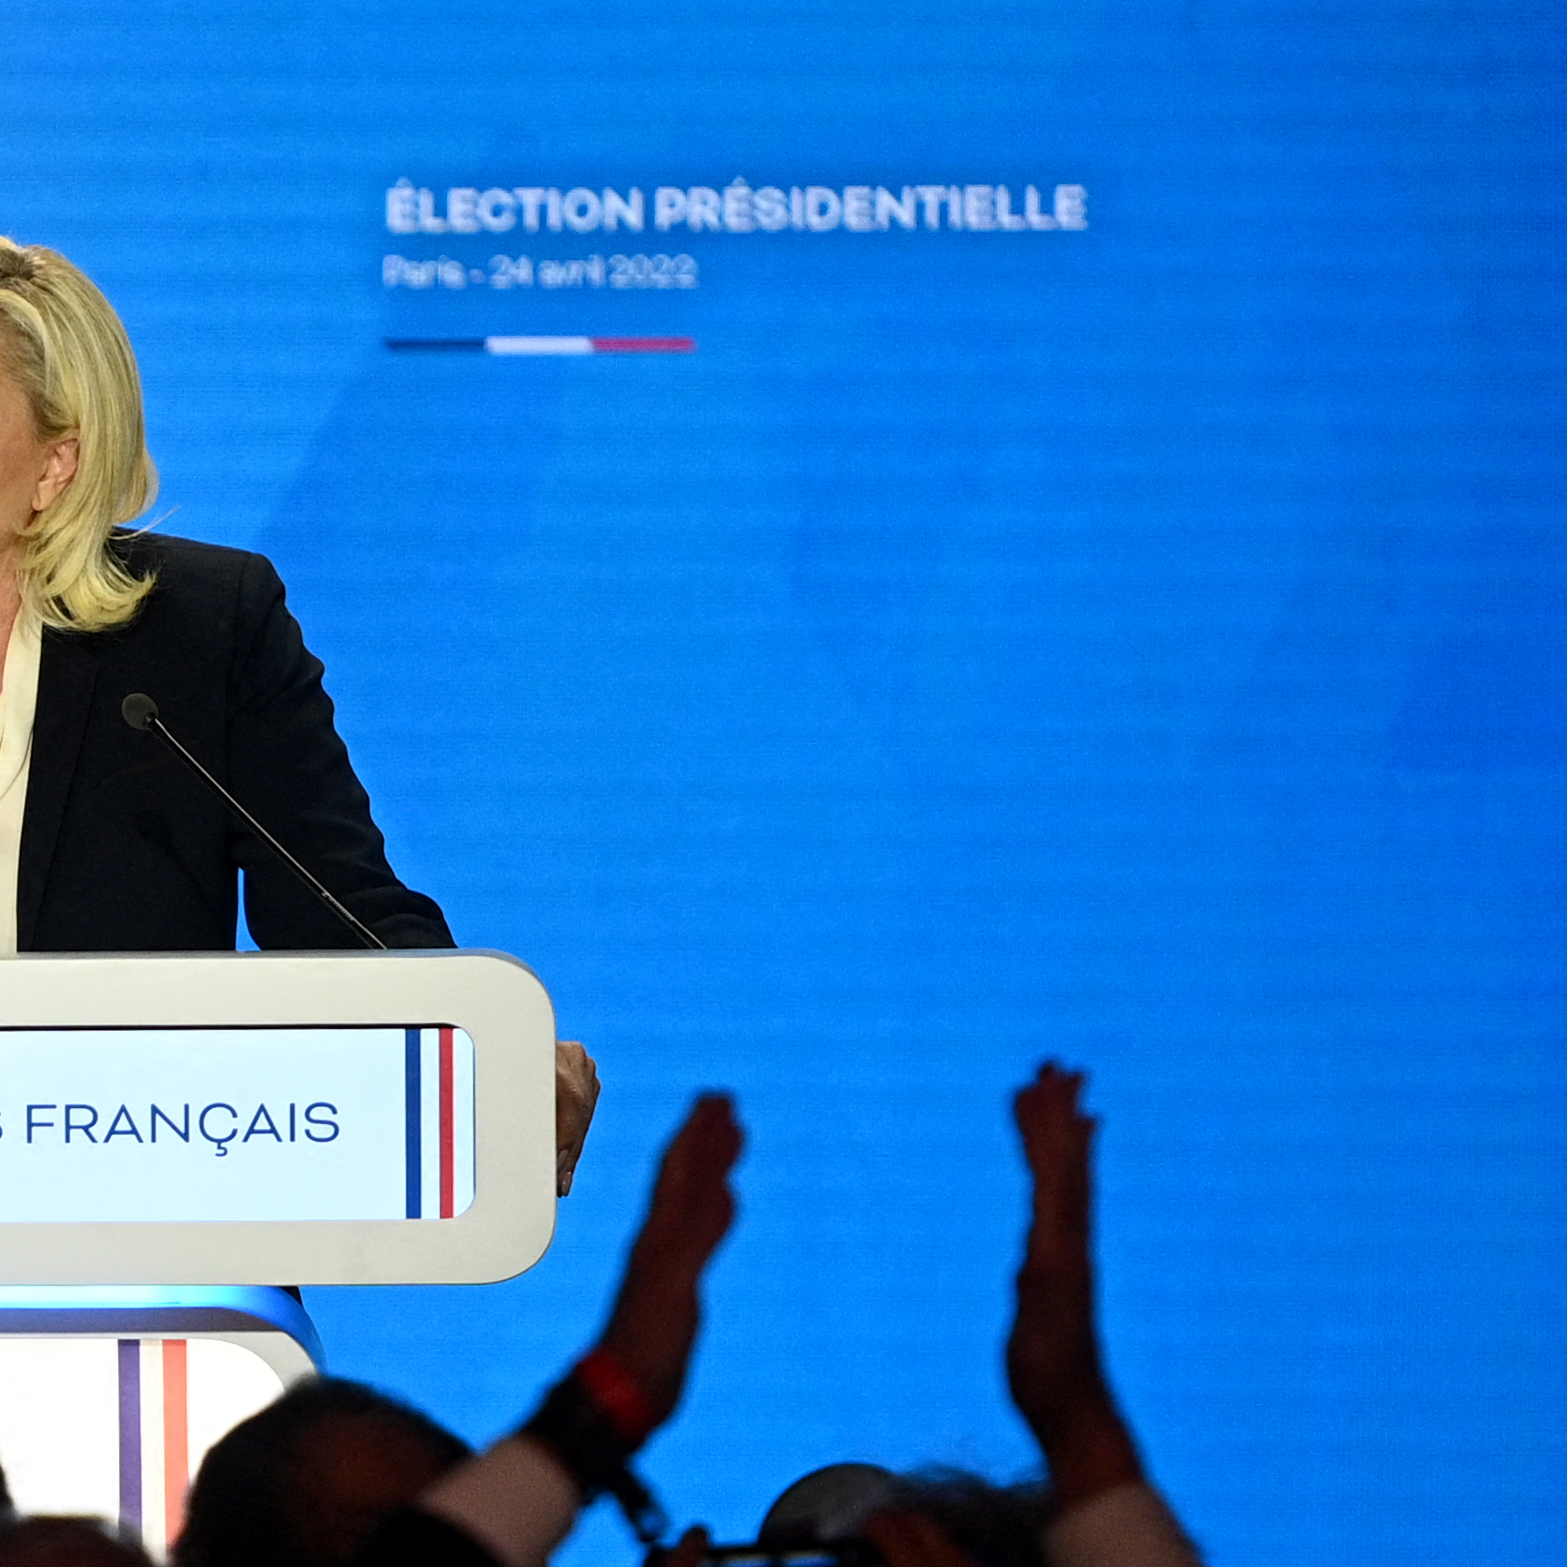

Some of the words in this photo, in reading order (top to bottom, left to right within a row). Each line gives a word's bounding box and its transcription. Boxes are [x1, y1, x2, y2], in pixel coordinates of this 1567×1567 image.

[386, 177, 645, 233] ÉLECTION
[655, 176, 1087, 232] PRÉSIDENTIELLE
[382, 255, 466, 288] Paris
[488, 255, 534, 288] 24
[538, 255, 606, 288] avril
[609, 255, 698, 288] 2022
[26, 1101, 341, 1157] FRANÇAIS
